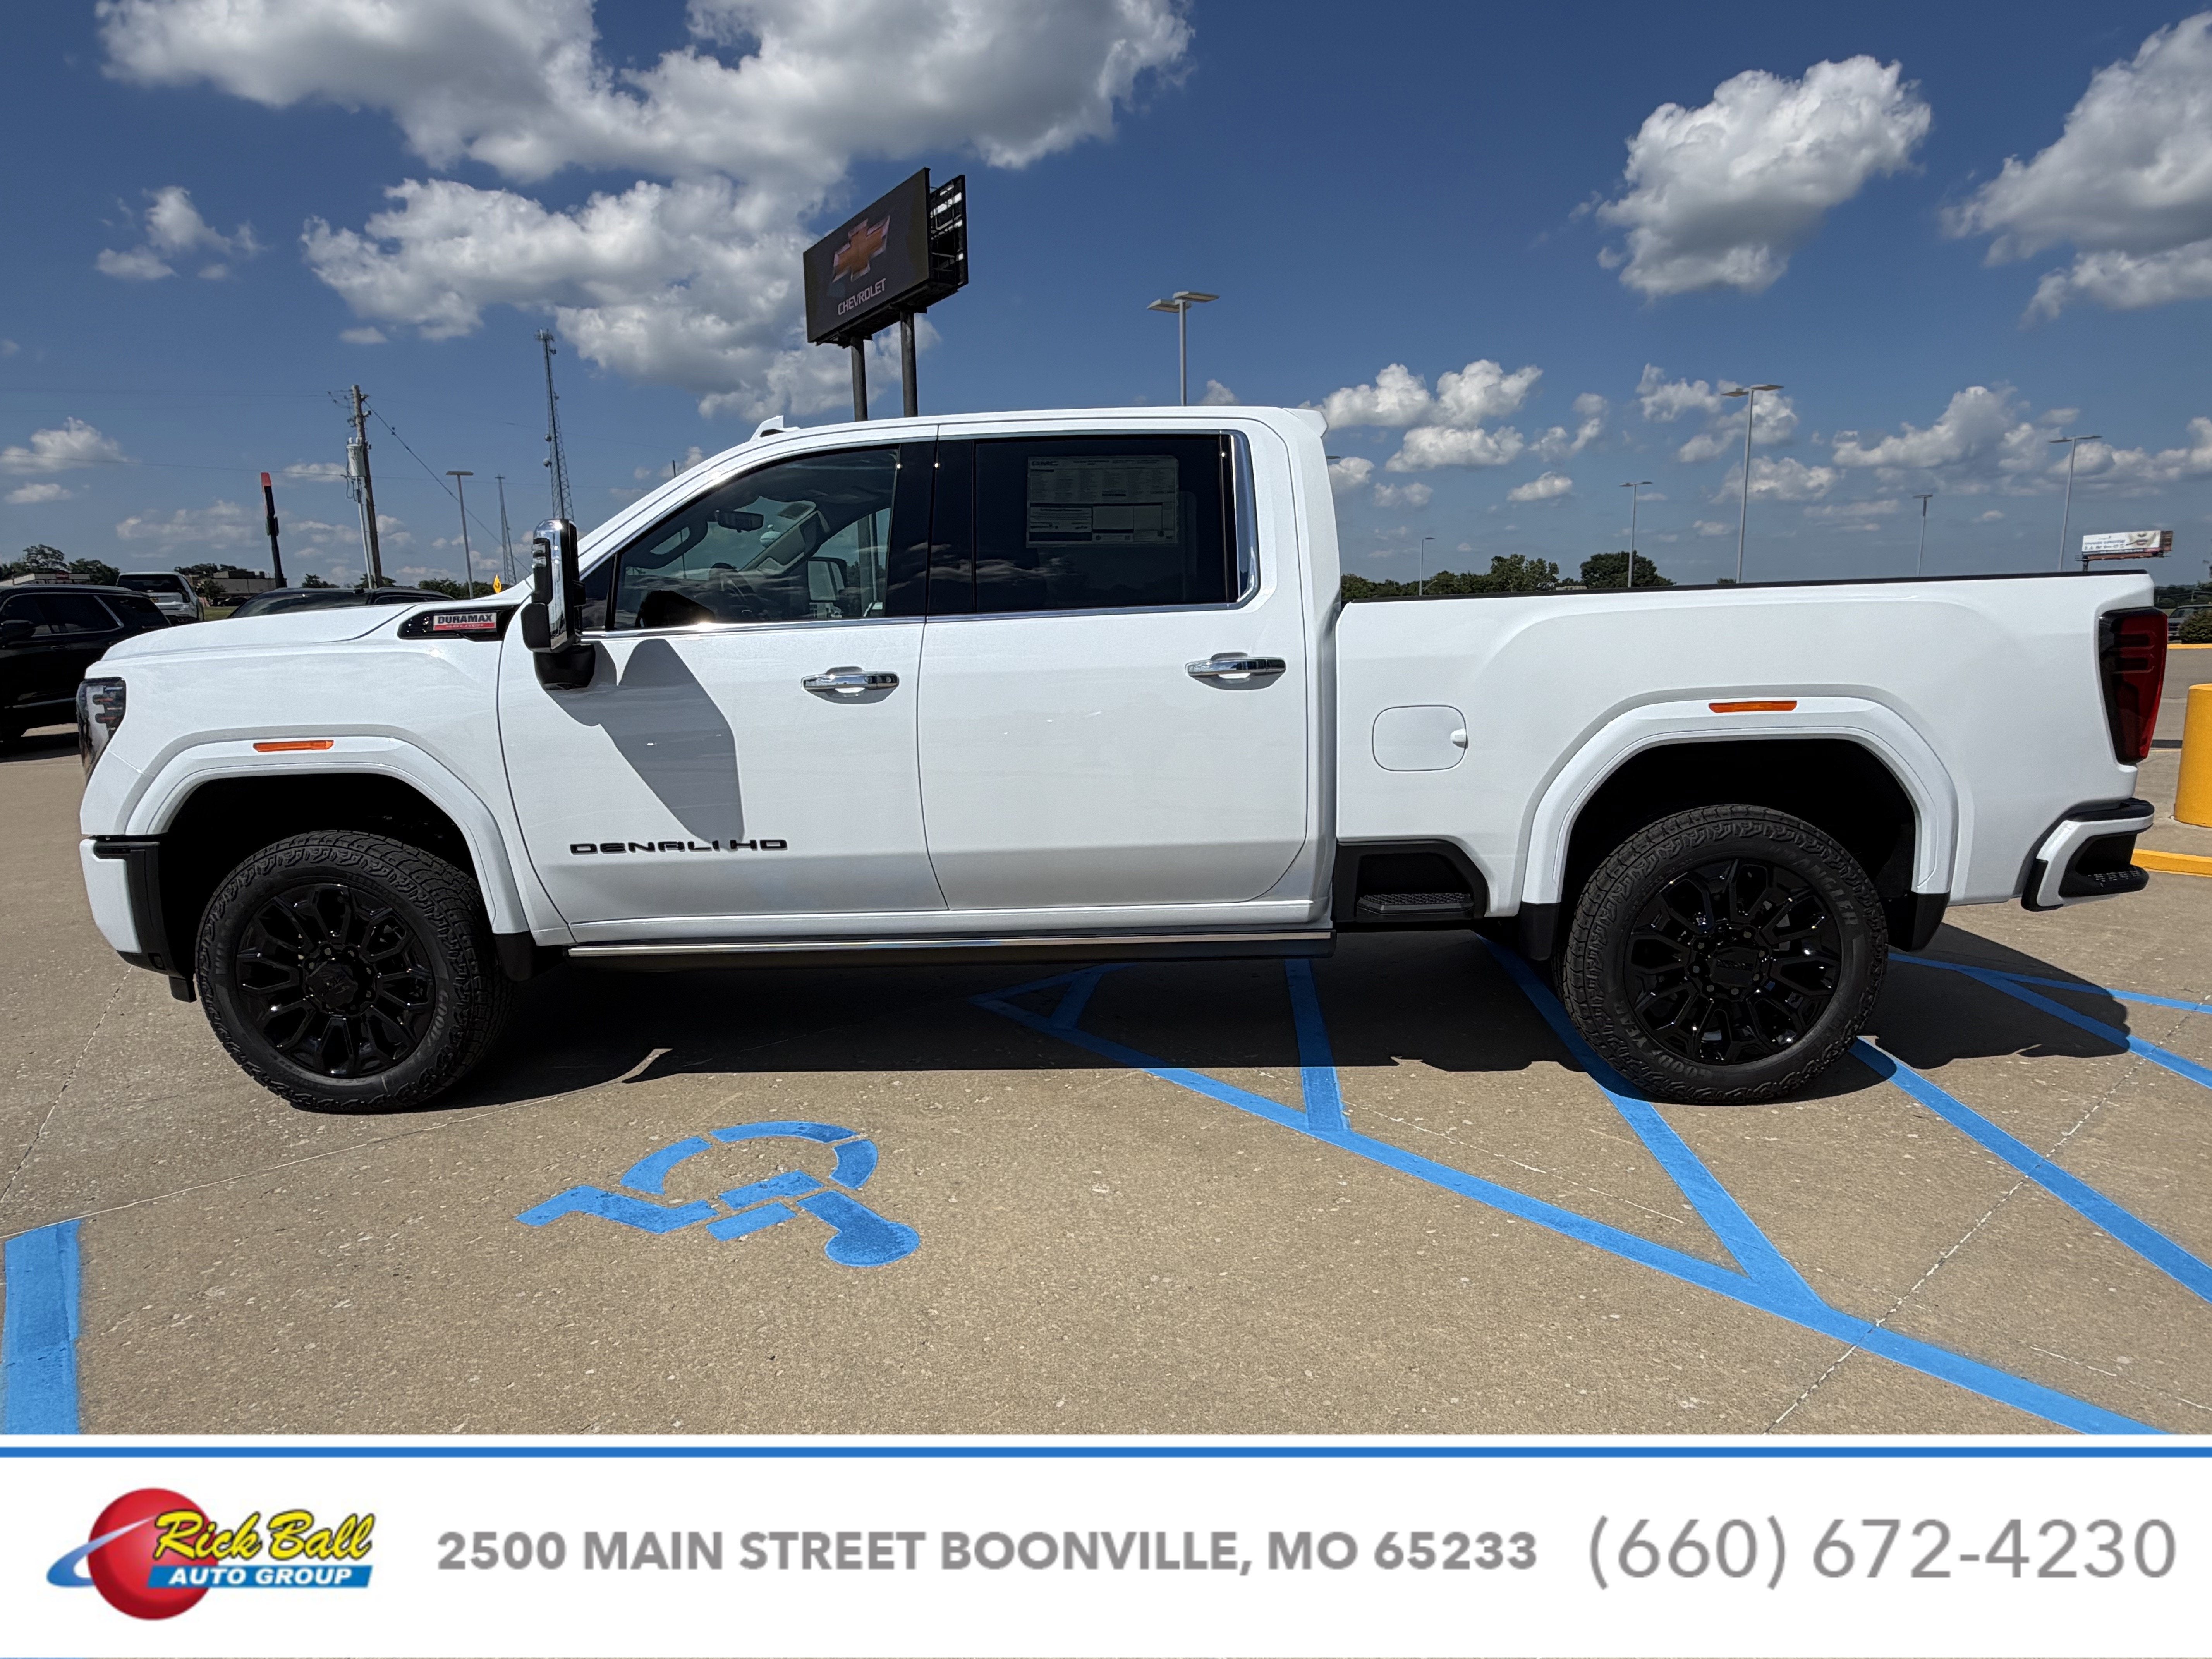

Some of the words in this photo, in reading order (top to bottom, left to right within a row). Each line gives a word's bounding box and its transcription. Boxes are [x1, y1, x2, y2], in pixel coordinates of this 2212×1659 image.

[838, 278, 886, 316] CHEVROLET
[438, 614, 493, 624] DURAMAX
[570, 840, 720, 855] DENALI
[730, 840, 788, 851] HD
